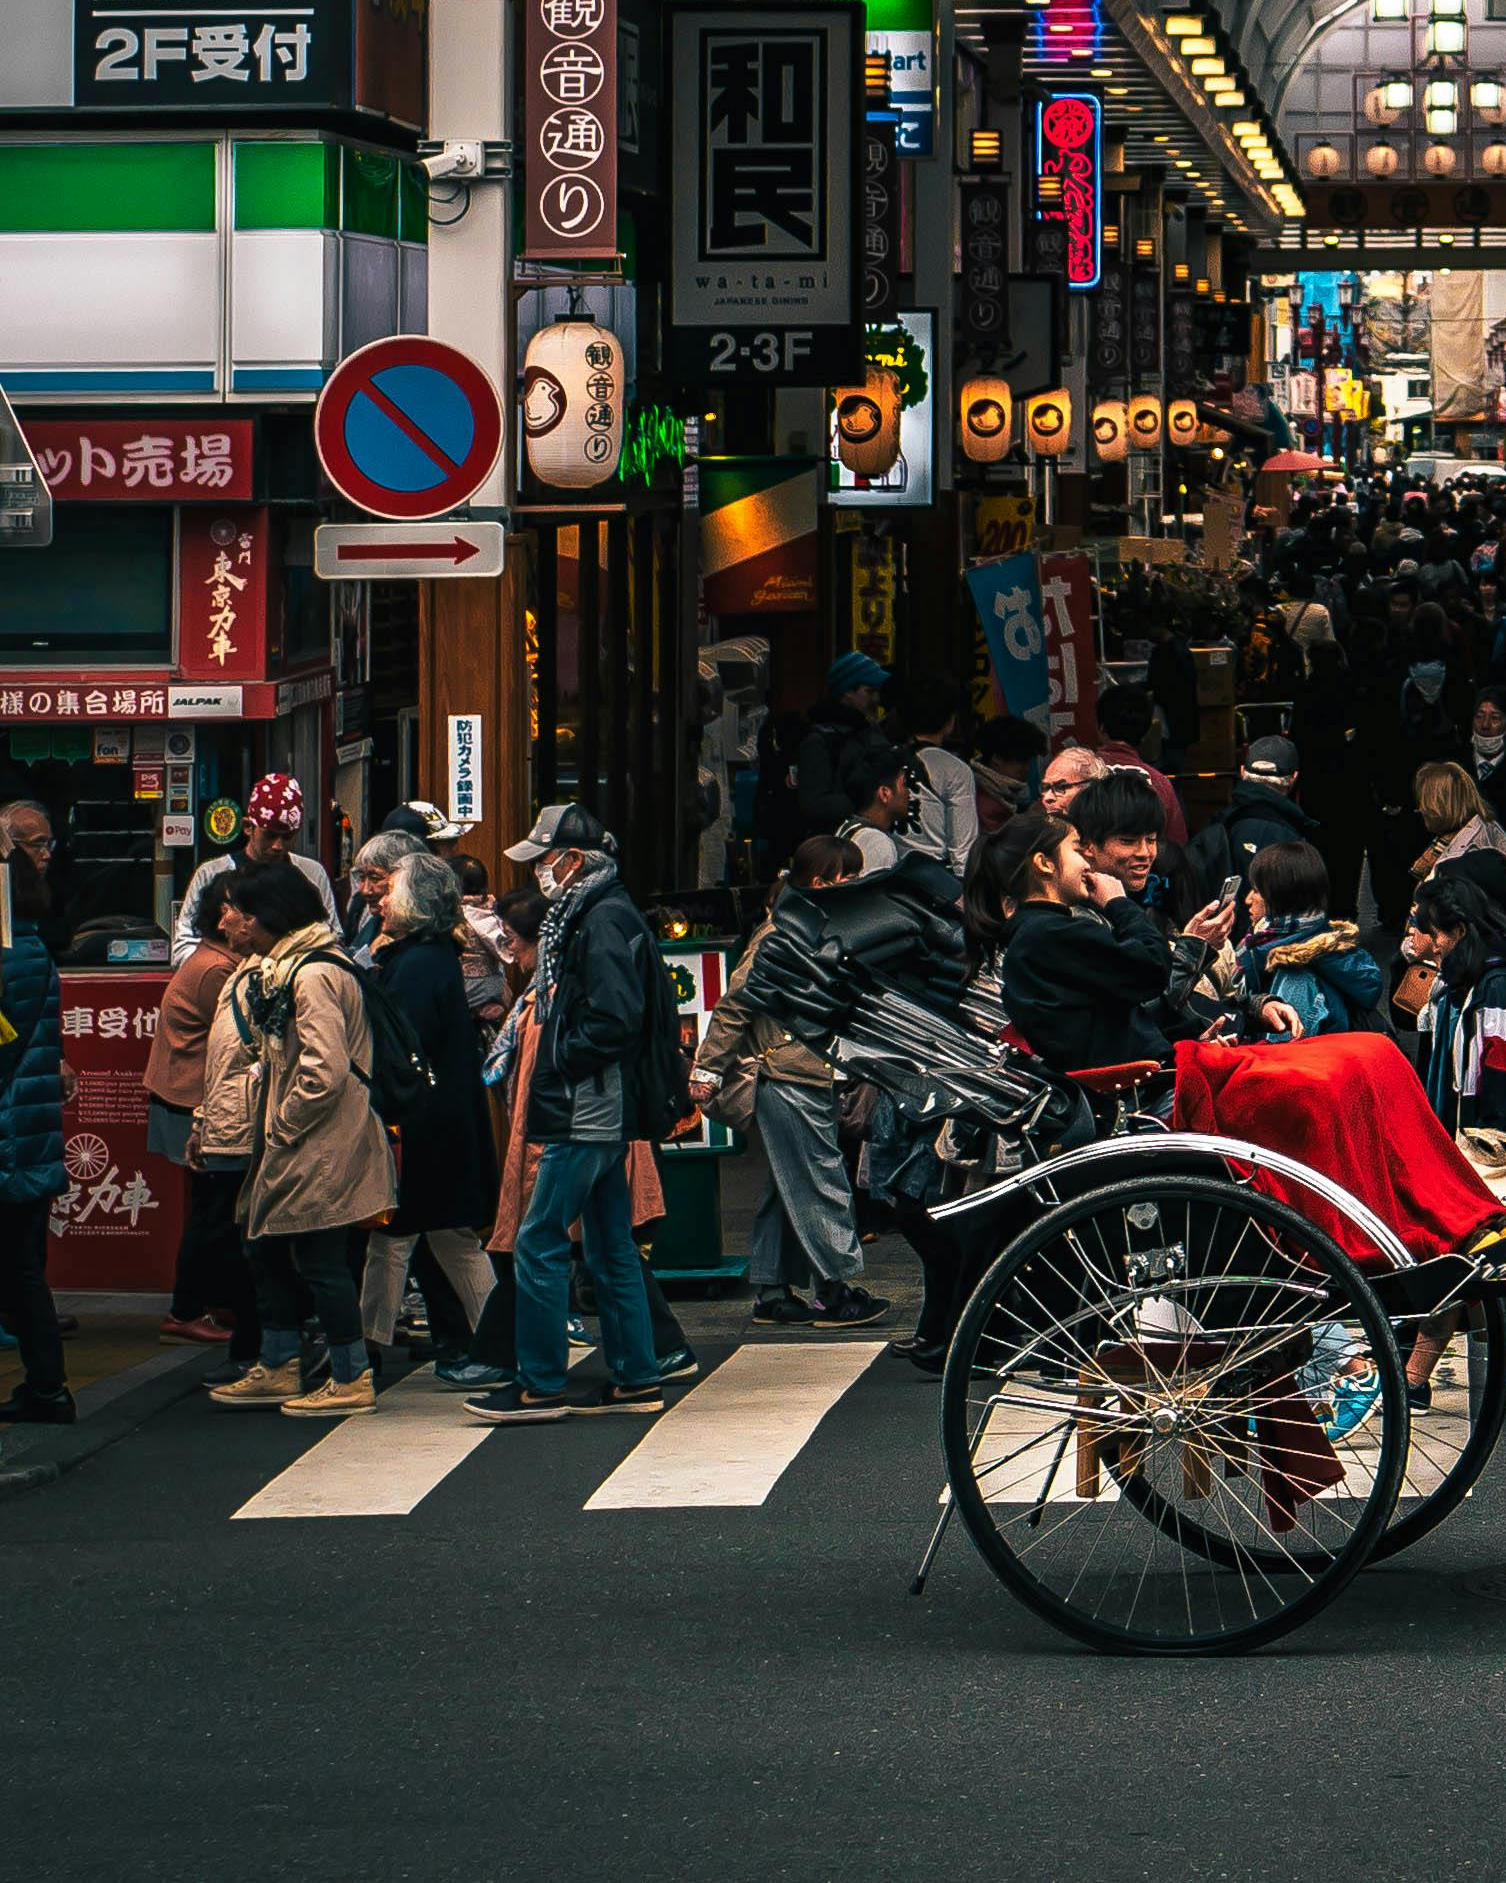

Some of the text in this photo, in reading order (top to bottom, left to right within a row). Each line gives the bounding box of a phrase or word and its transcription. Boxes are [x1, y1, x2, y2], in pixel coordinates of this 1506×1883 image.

[93, 25, 311, 82] 2F受付
[709, 39, 818, 253] 和民
[586, 342, 613, 462] 観音通り
[204, 551, 247, 667] 東京力車
[172, 698, 222, 706] JALPAK
[456, 719, 474, 817] 防犯カメラ録画中
